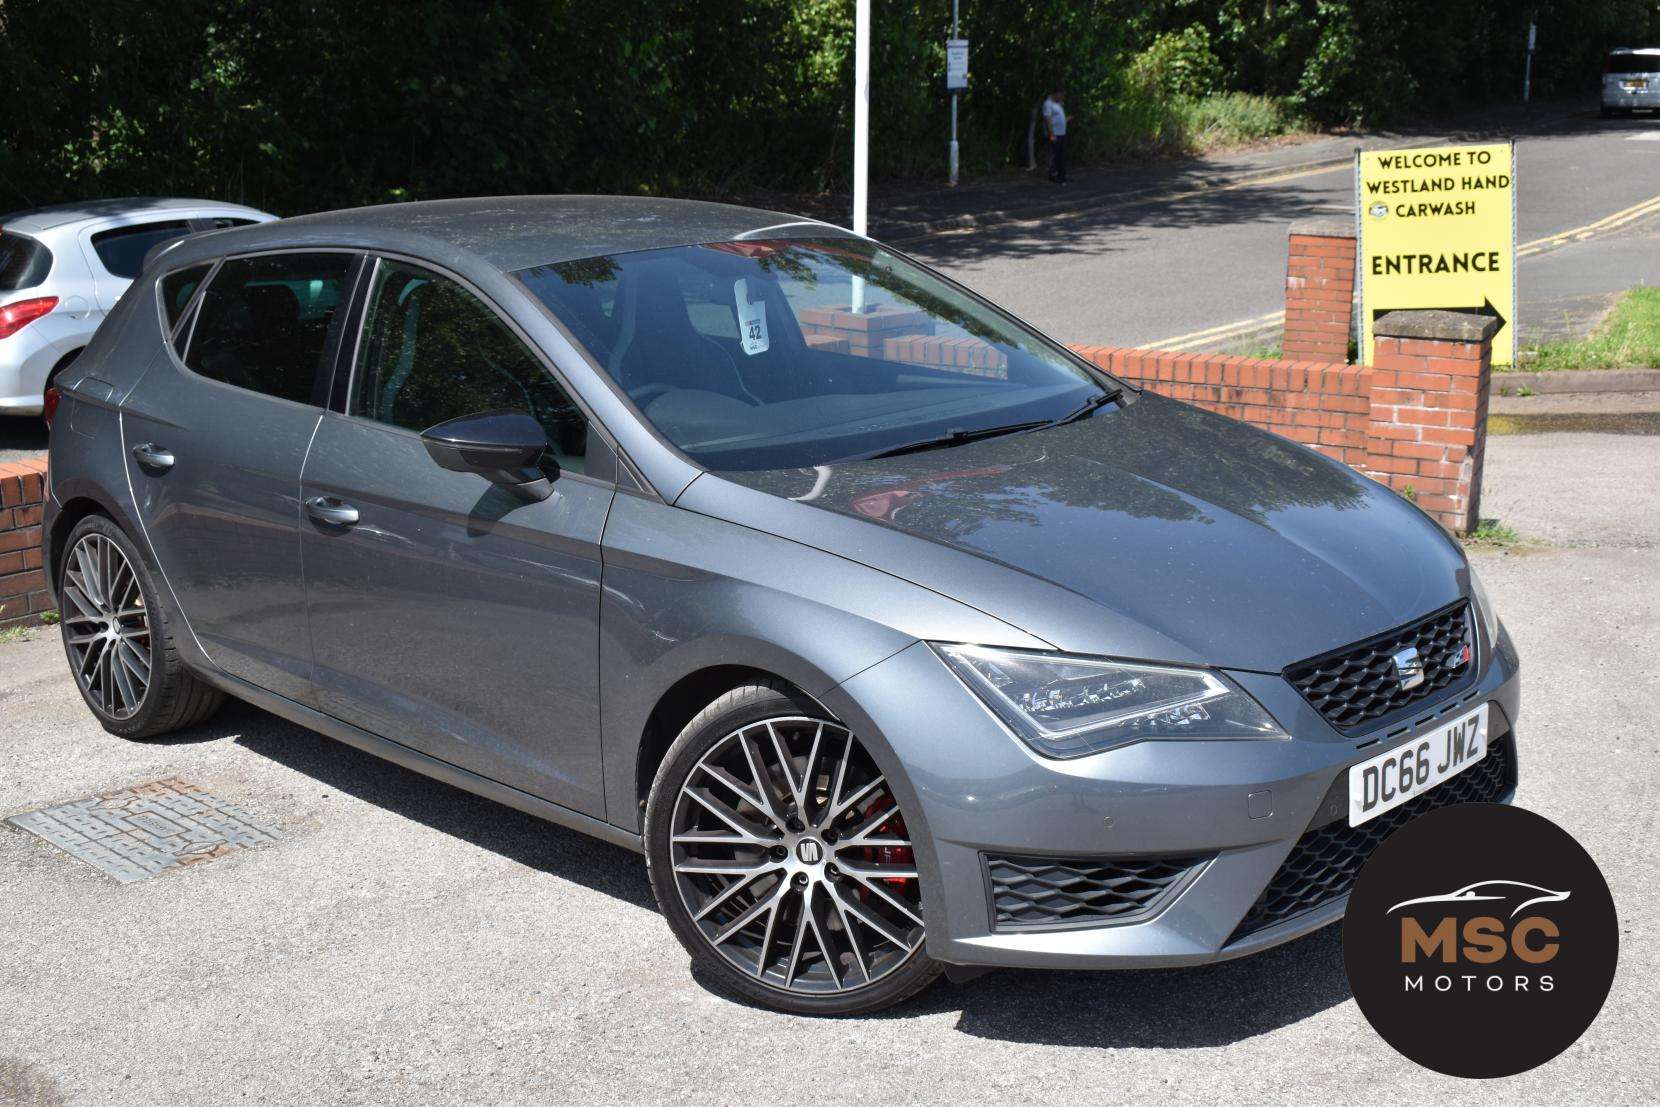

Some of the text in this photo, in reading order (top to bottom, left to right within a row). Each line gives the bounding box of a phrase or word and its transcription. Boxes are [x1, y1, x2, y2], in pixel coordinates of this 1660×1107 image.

[1378, 151, 1491, 169] WELCOME TO
[1367, 175, 1510, 195] WESTLAND HAND
[1396, 202, 1475, 218] CARWASH
[1372, 252, 1500, 275] ENTRANCE
[749, 325, 762, 340] 42
[1362, 714, 1480, 813] DC66 JWZ
